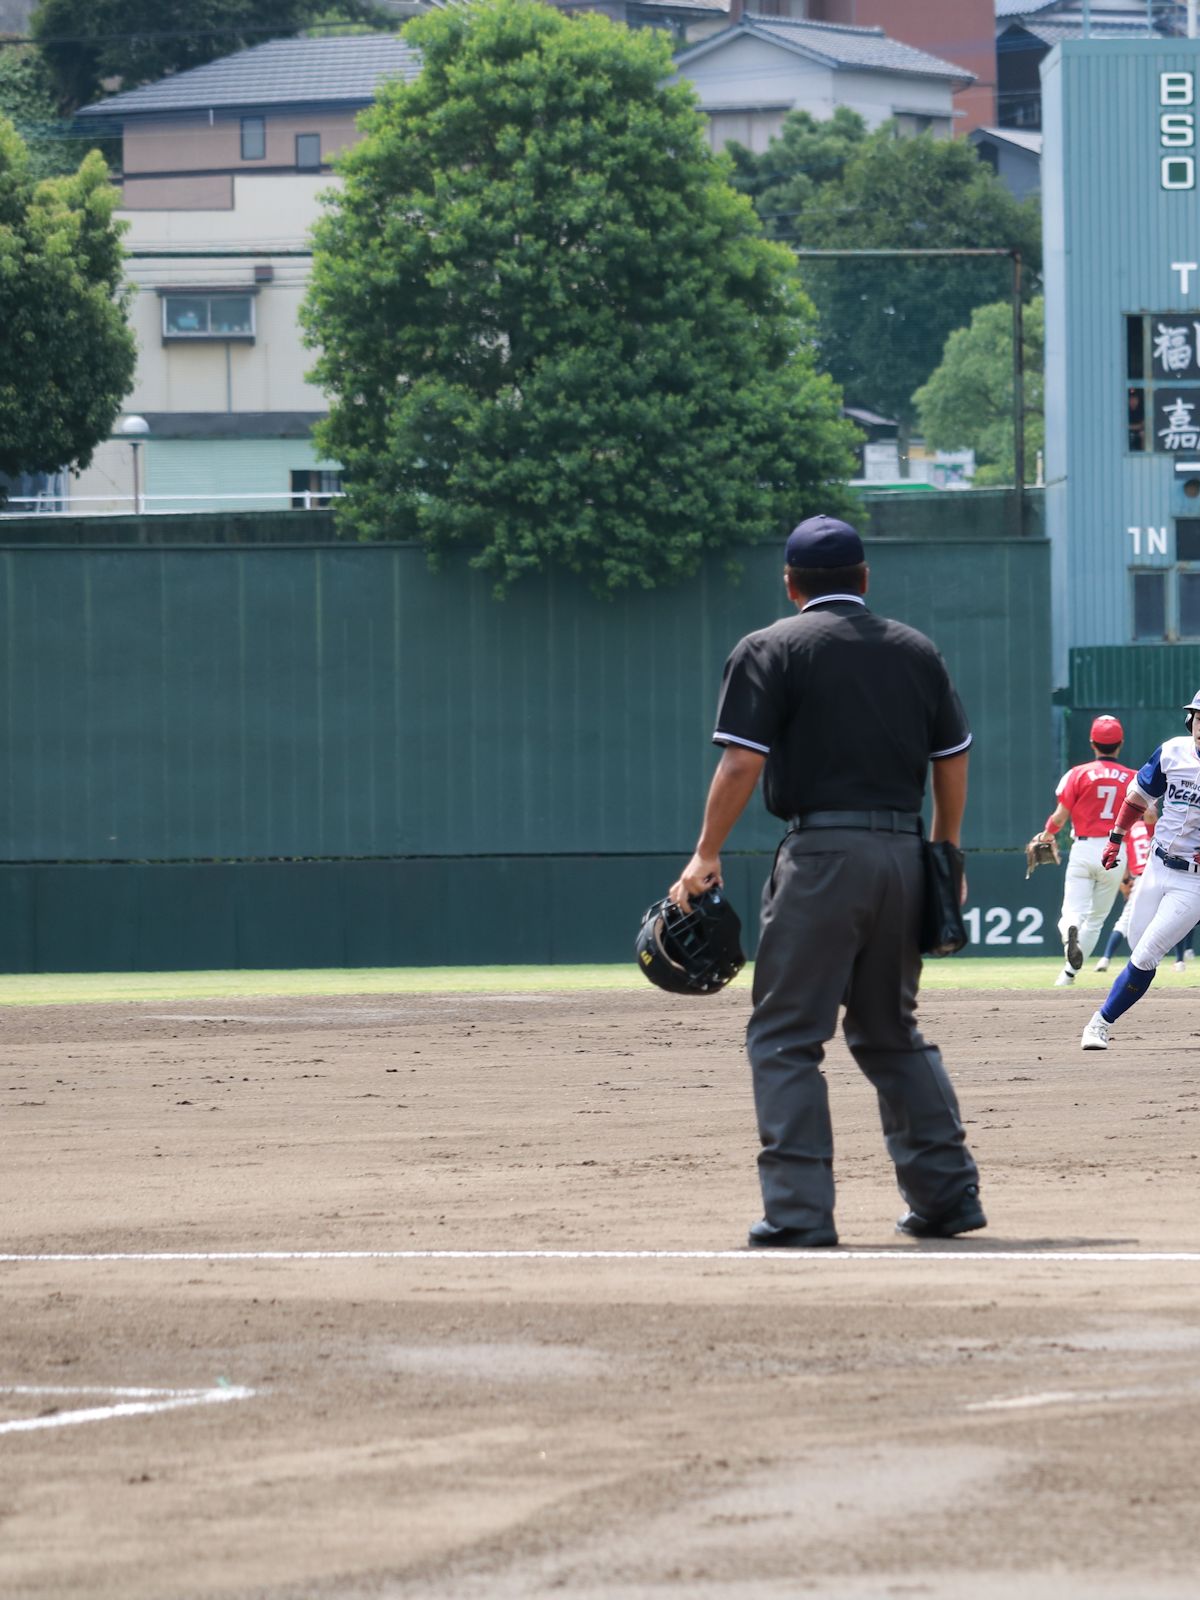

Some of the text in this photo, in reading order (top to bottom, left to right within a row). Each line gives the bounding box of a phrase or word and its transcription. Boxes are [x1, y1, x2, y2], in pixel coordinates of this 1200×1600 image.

[1161, 73, 1193, 105] B
[1161, 114, 1193, 146] S
[1096, 785, 1118, 820] 7
[962, 906, 1044, 945] 122
